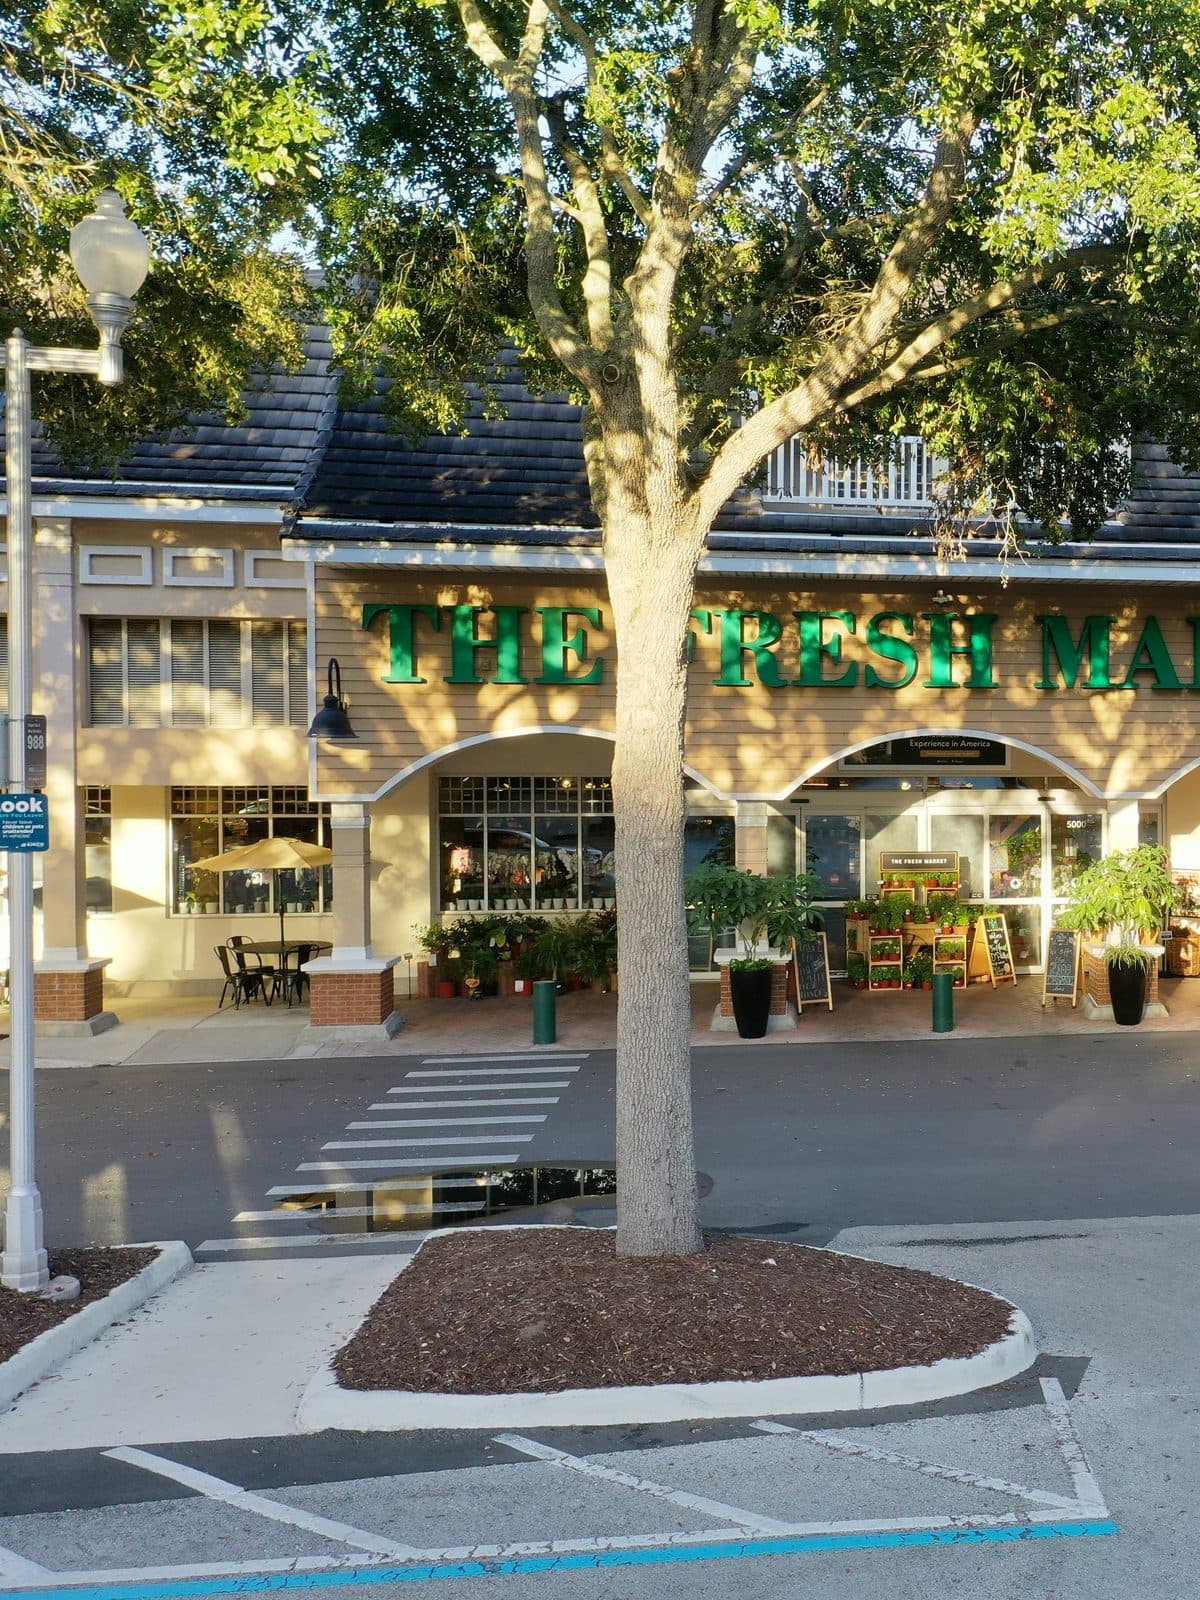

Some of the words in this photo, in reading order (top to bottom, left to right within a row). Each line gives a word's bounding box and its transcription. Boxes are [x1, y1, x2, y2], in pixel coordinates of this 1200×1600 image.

[362, 604, 603, 684] THE
[27, 735, 44, 750] 988
[910, 740, 950, 749] Experience
[961, 740, 991, 748] America
[0, 797, 43, 812] ook
[1066, 821, 1086, 829] 5000
